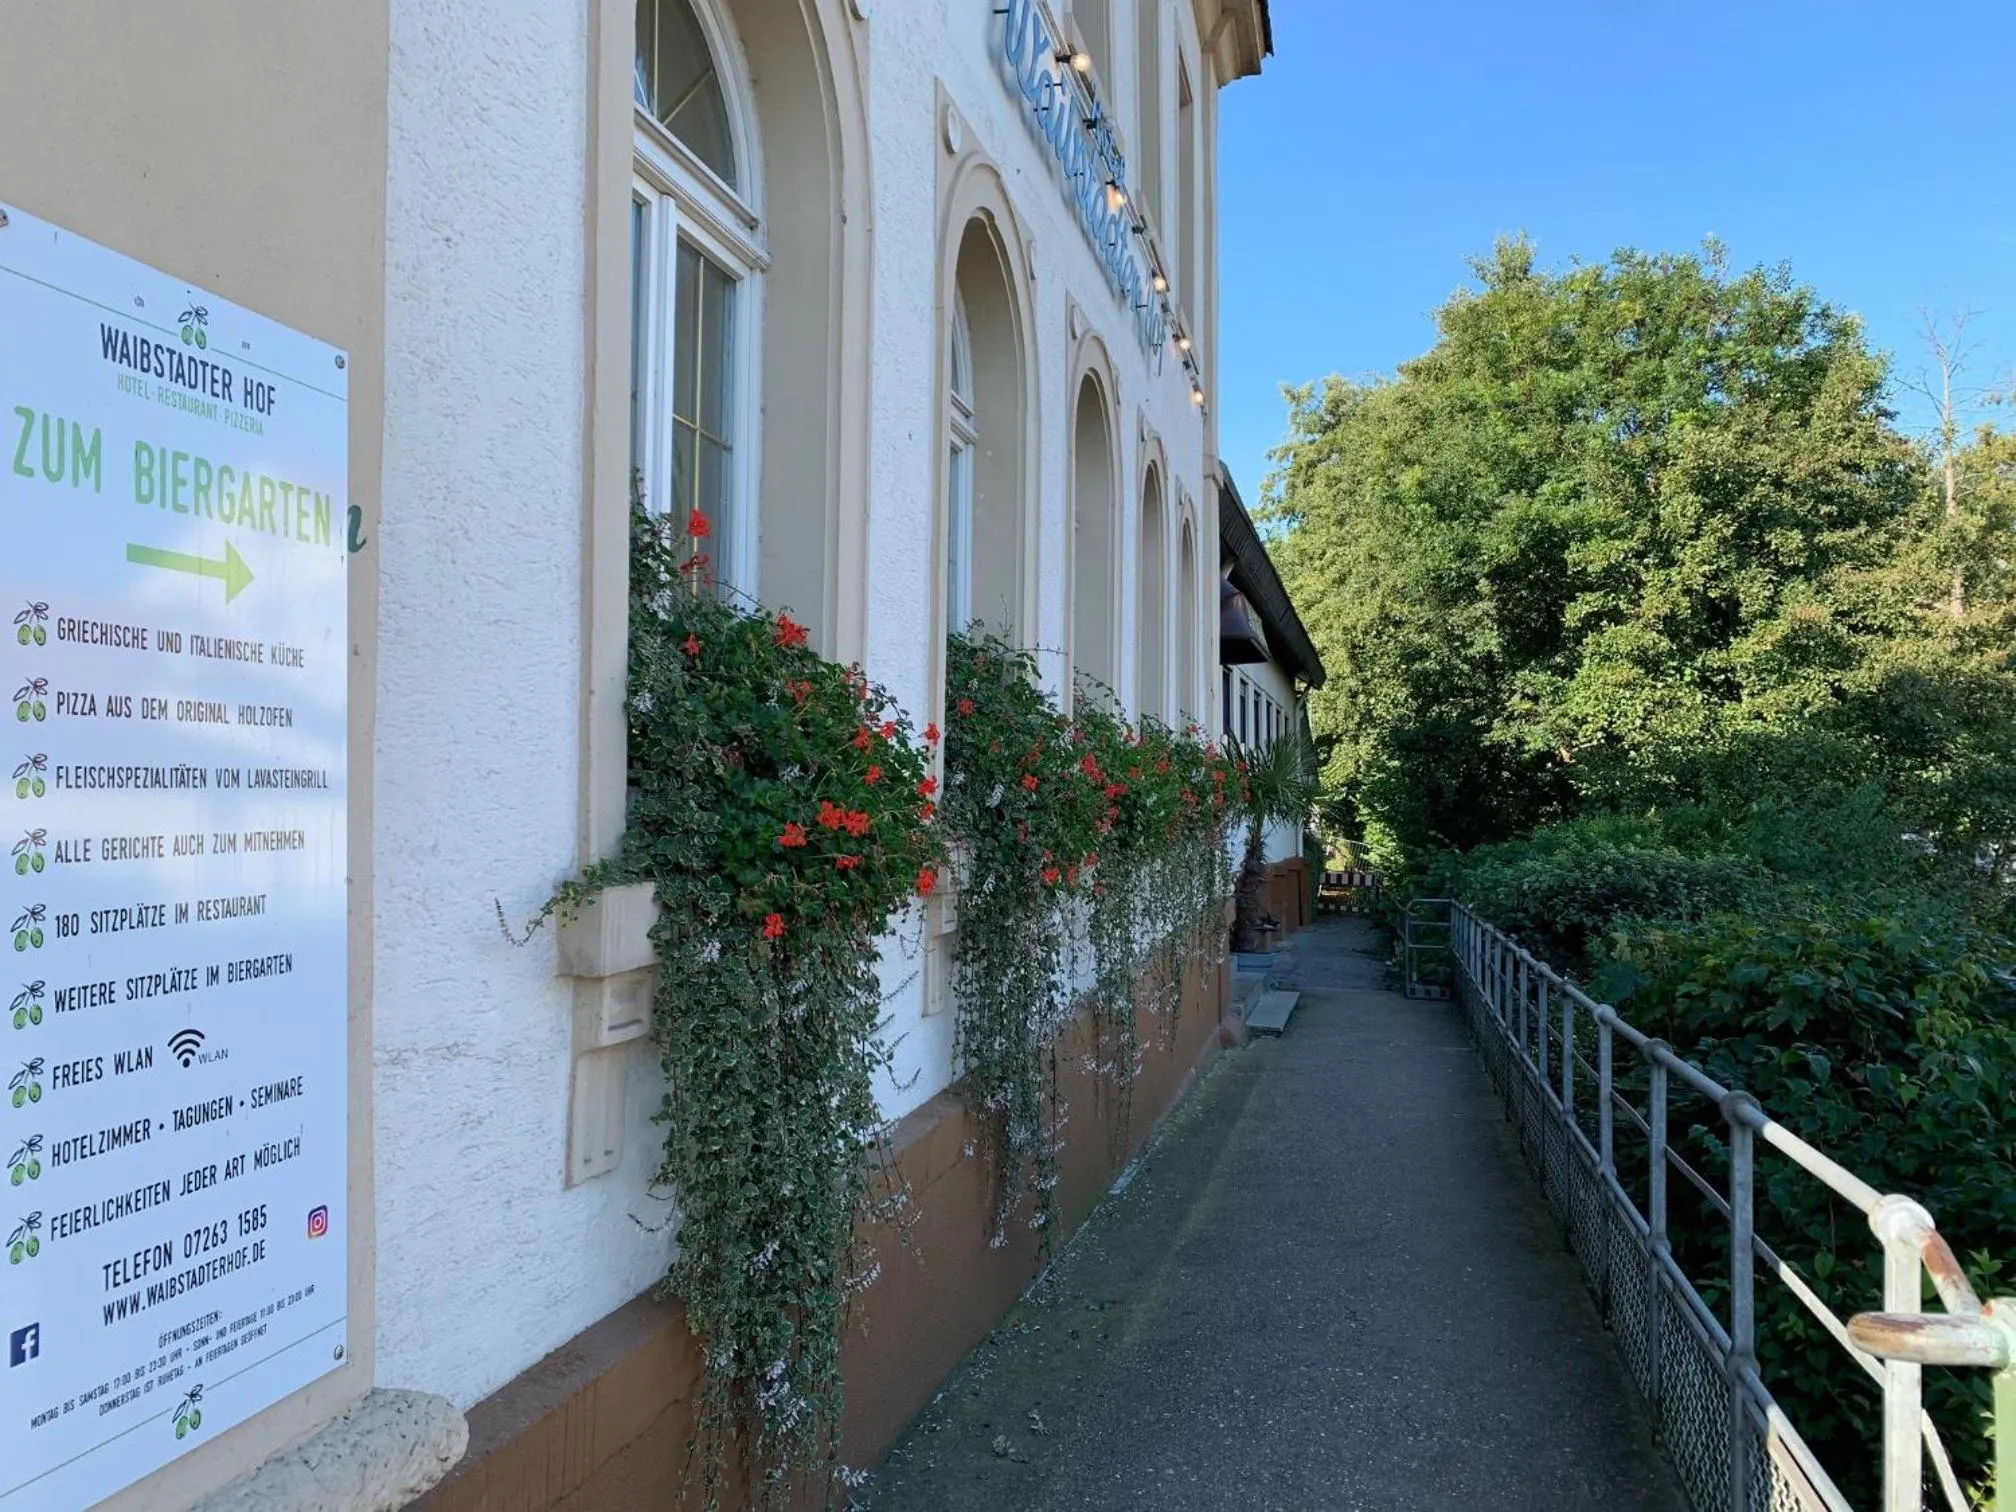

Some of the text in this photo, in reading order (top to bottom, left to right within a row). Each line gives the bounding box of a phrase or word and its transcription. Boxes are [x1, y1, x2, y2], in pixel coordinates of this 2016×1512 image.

[100, 322, 276, 417] WAIBSTADTER HOF
[117, 373, 264, 435] HOTEL RESTAURANT PIZZERIA
[13, 406, 101, 493] ZUM
[135, 441, 330, 546] BIERGARTEN
[57, 618, 304, 668] GRIECHISCHE UND ITALIENISCHE KÜCHE
[57, 691, 293, 728] PIZZA AUS DEM ORIGINAL HOLZOFEN
[56, 764, 329, 789] FLEISCHSPEZIALITÄTEN VOM LAVASTEINGRILL
[55, 829, 305, 863] ALLE GERICHTE AUCH ZUM MITNEHMEN
[55, 894, 266, 938] 180 SITZPLÄTZE IM RESTAURANT
[54, 954, 292, 1013] WEITERE SITZPLÄTZE IM BIERGARTEN
[53, 1045, 153, 1090] FREIES WLAN
[198, 1048, 229, 1065] WLAN
[52, 1076, 304, 1167] HOTELZIMMER TAGUNGEN SEMINARE
[51, 1136, 301, 1241] FEIERLICHKEITEN JEDER ART MÖGLICH
[103, 1204, 267, 1291] TELEFON 07263 1585
[103, 1239, 266, 1326] WWW.WAIBSTADTERHOF.DE
[30, 1406, 58, 1429] MONTAG
[63, 1399, 75, 1415] BIS
[79, 1383, 109, 1406] SAMSTAG
[135, 1366, 145, 1380] BIS
[170, 1347, 182, 1362] UHR
[216, 1326, 227, 1340] UND
[99, 1387, 140, 1416] DONNERSTAG
[144, 1379, 154, 1393] IST
[158, 1365, 184, 1387] RUHETAG
